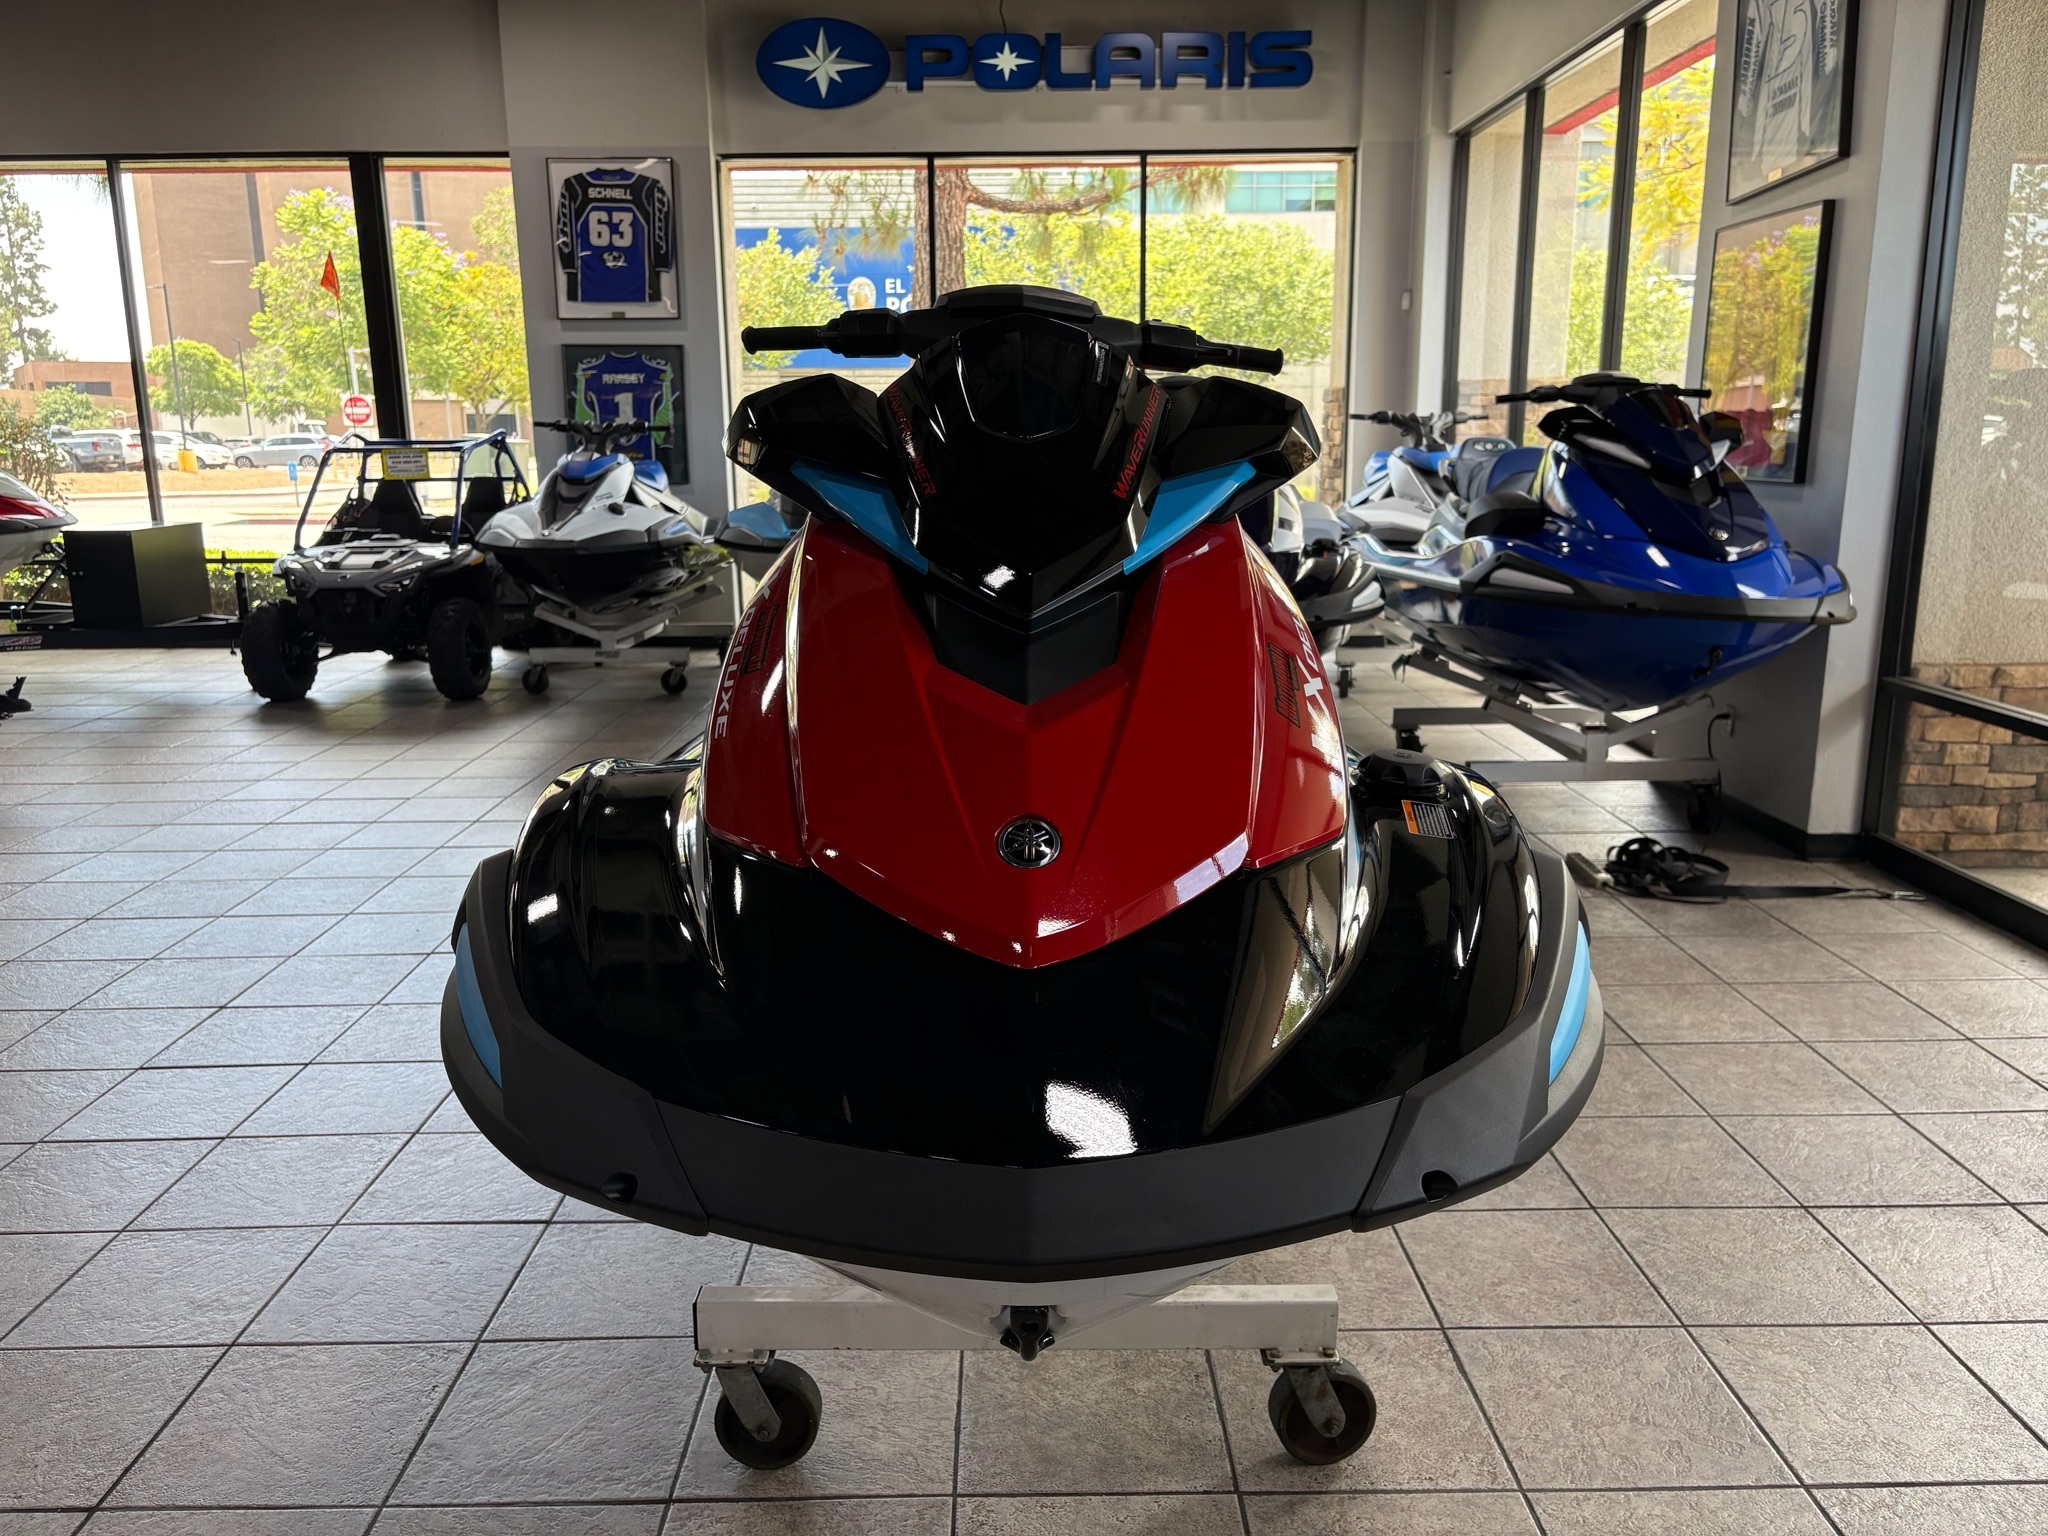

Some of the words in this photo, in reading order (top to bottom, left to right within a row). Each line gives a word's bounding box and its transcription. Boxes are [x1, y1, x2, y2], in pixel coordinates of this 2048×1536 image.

[905, 30, 1313, 92] POLARIS
[588, 187, 633, 200] SCHNELL
[588, 210, 634, 247] 63
[885, 278, 906, 294] EL
[602, 373, 645, 384] RAMSEY
[614, 392, 637, 424] 1
[1113, 384, 1160, 499] WAVERUNNER
[714, 606, 756, 739] DELUXE
